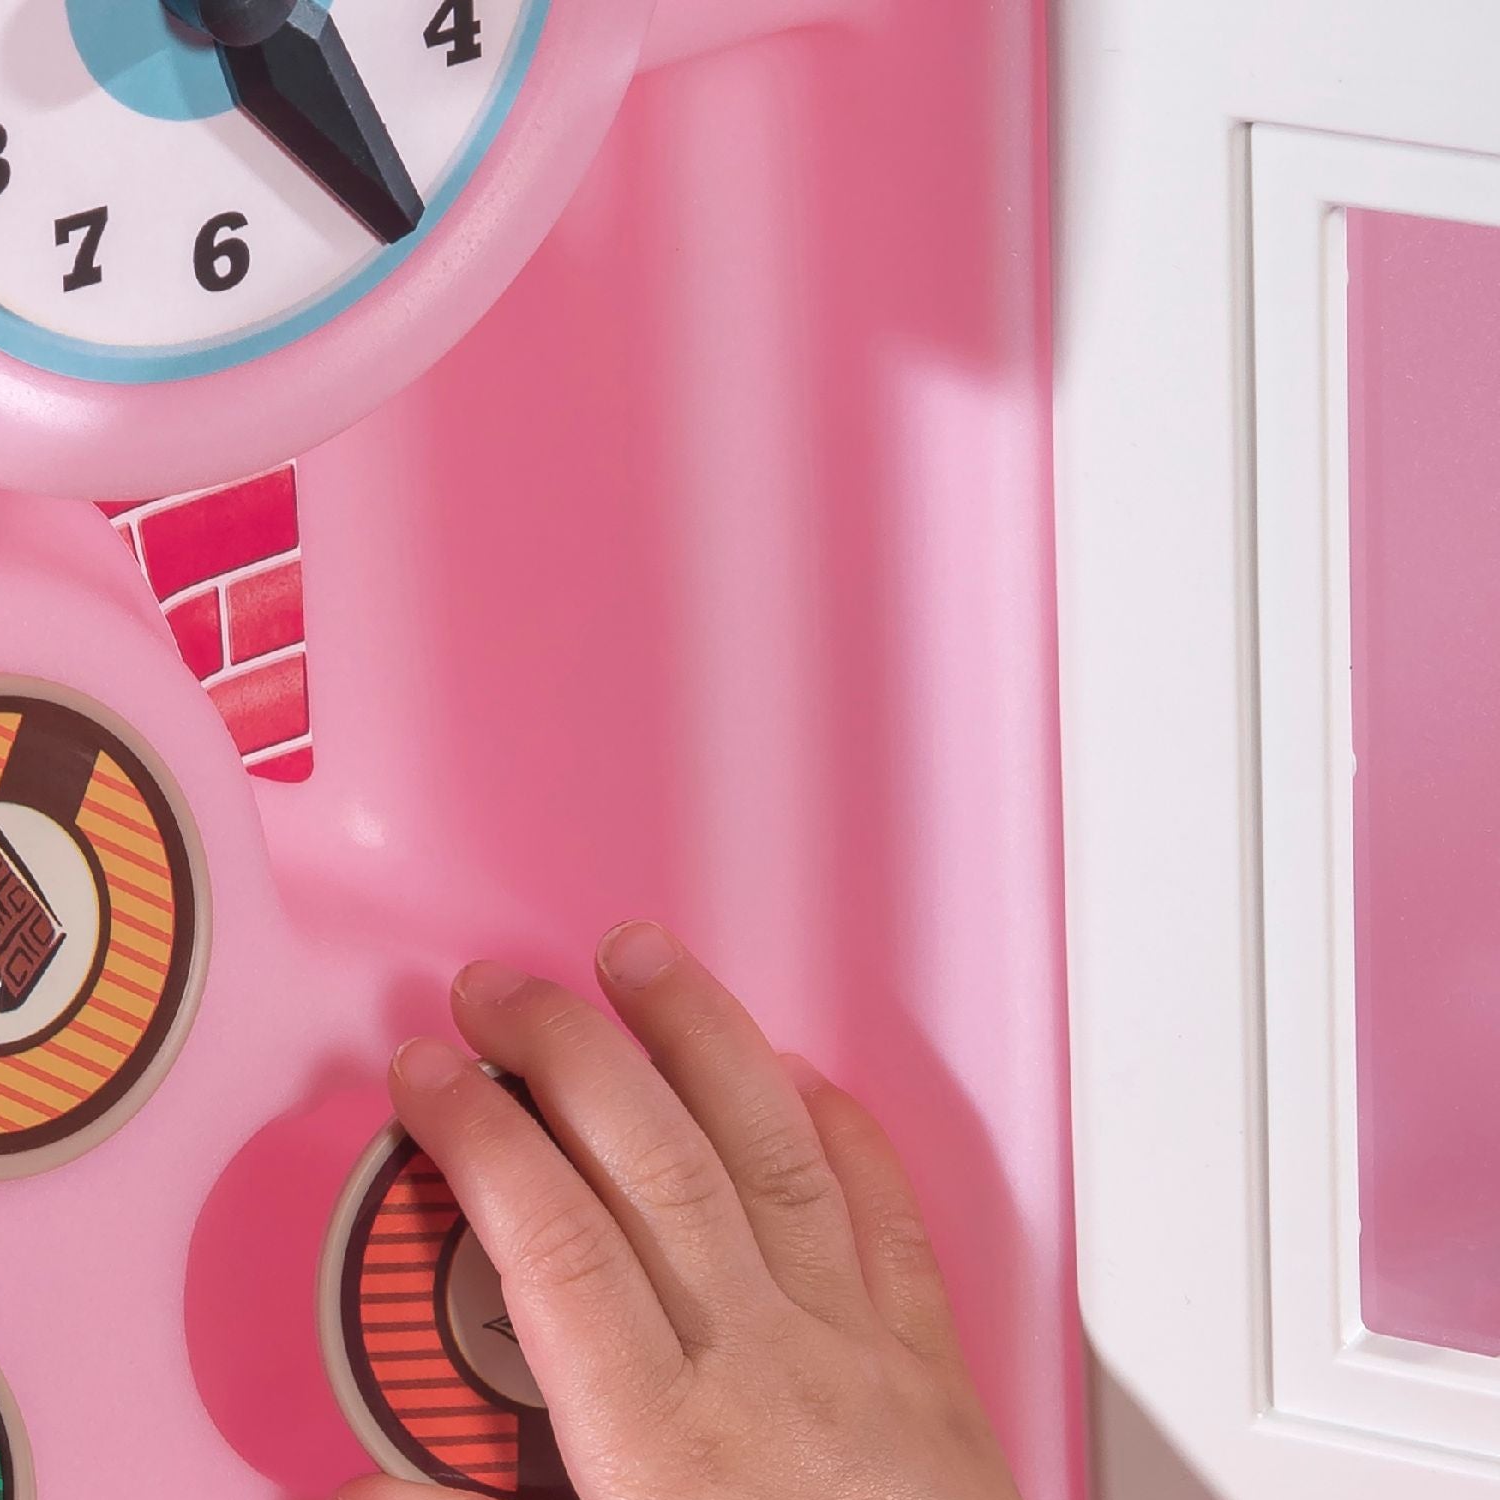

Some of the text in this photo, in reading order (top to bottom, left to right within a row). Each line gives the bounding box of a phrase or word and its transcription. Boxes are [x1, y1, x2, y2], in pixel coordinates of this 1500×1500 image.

[423, 0, 482, 67] 4
[54, 206, 108, 292] 7
[193, 211, 250, 292] 6
